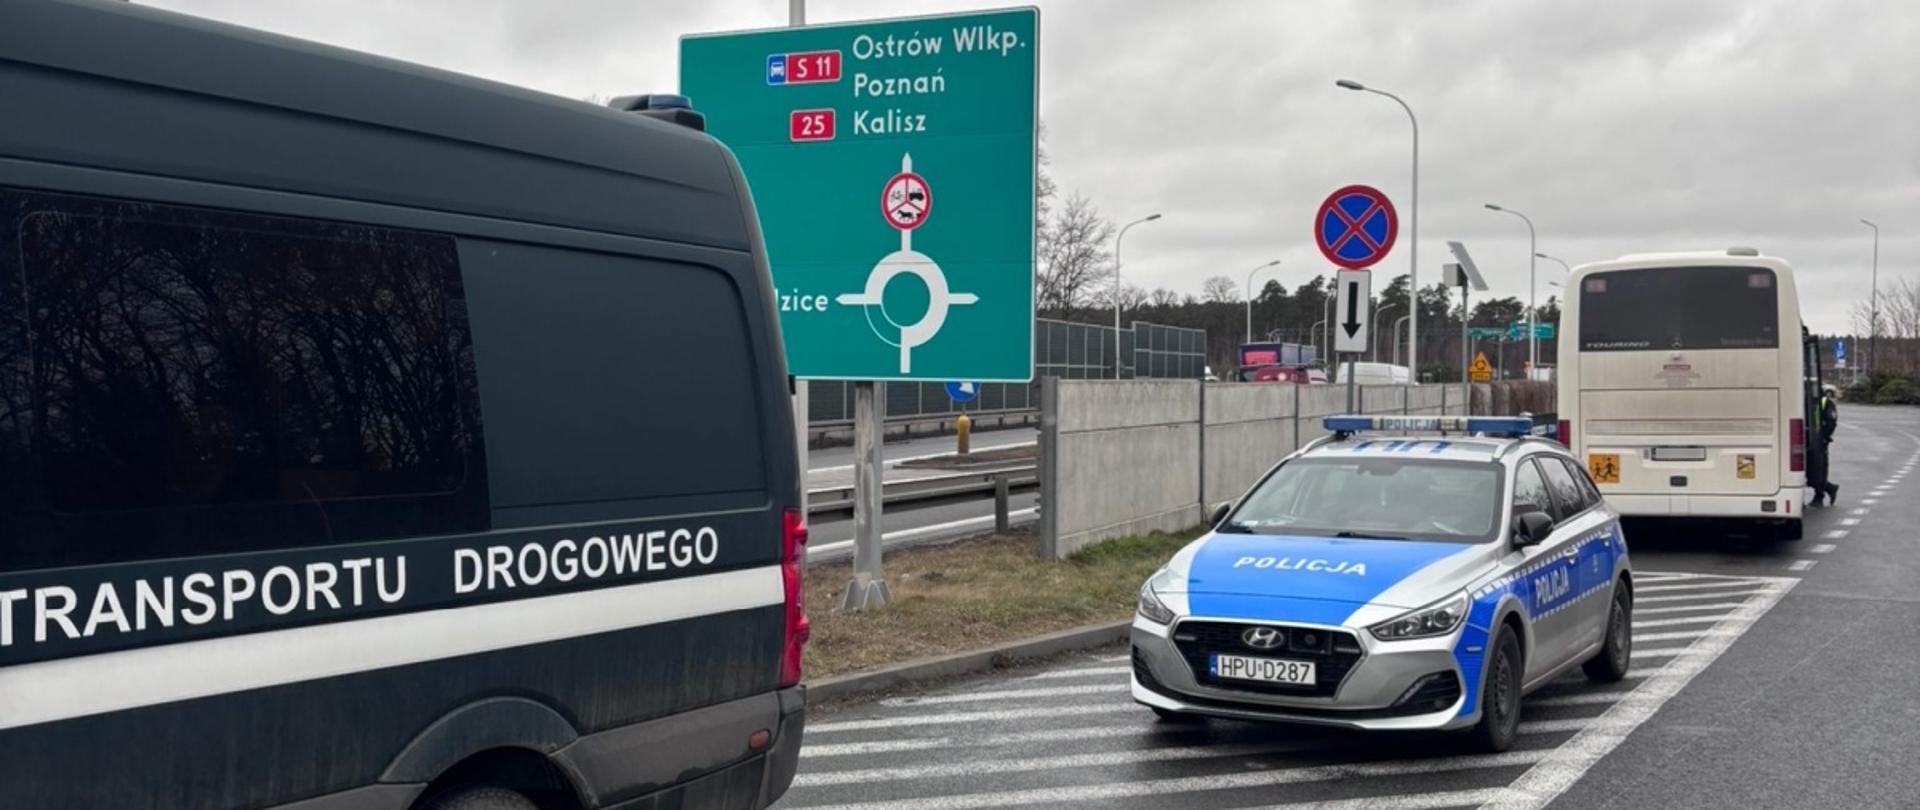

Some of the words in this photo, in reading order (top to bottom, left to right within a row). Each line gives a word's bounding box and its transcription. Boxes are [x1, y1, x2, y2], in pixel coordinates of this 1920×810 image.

[852, 31, 943, 60] Ostrów
[953, 26, 1026, 56] Wlkp.
[796, 57, 809, 78] S
[815, 56, 832, 77] 11
[853, 68, 946, 97] Poznań
[801, 116, 826, 136] 25
[853, 109, 927, 135] Kalisz
[775, 288, 829, 311] zice
[1586, 341, 1651, 349] TOURINO
[1386, 417, 1439, 430] POLICJA
[1233, 555, 1367, 577] POLICJA
[0, 554, 407, 647] TRANSPORTU
[454, 526, 719, 594] DROGOWEGO
[1535, 565, 1570, 608] POLICJA
[1221, 656, 1258, 679] HPU
[1263, 660, 1310, 683] D287
